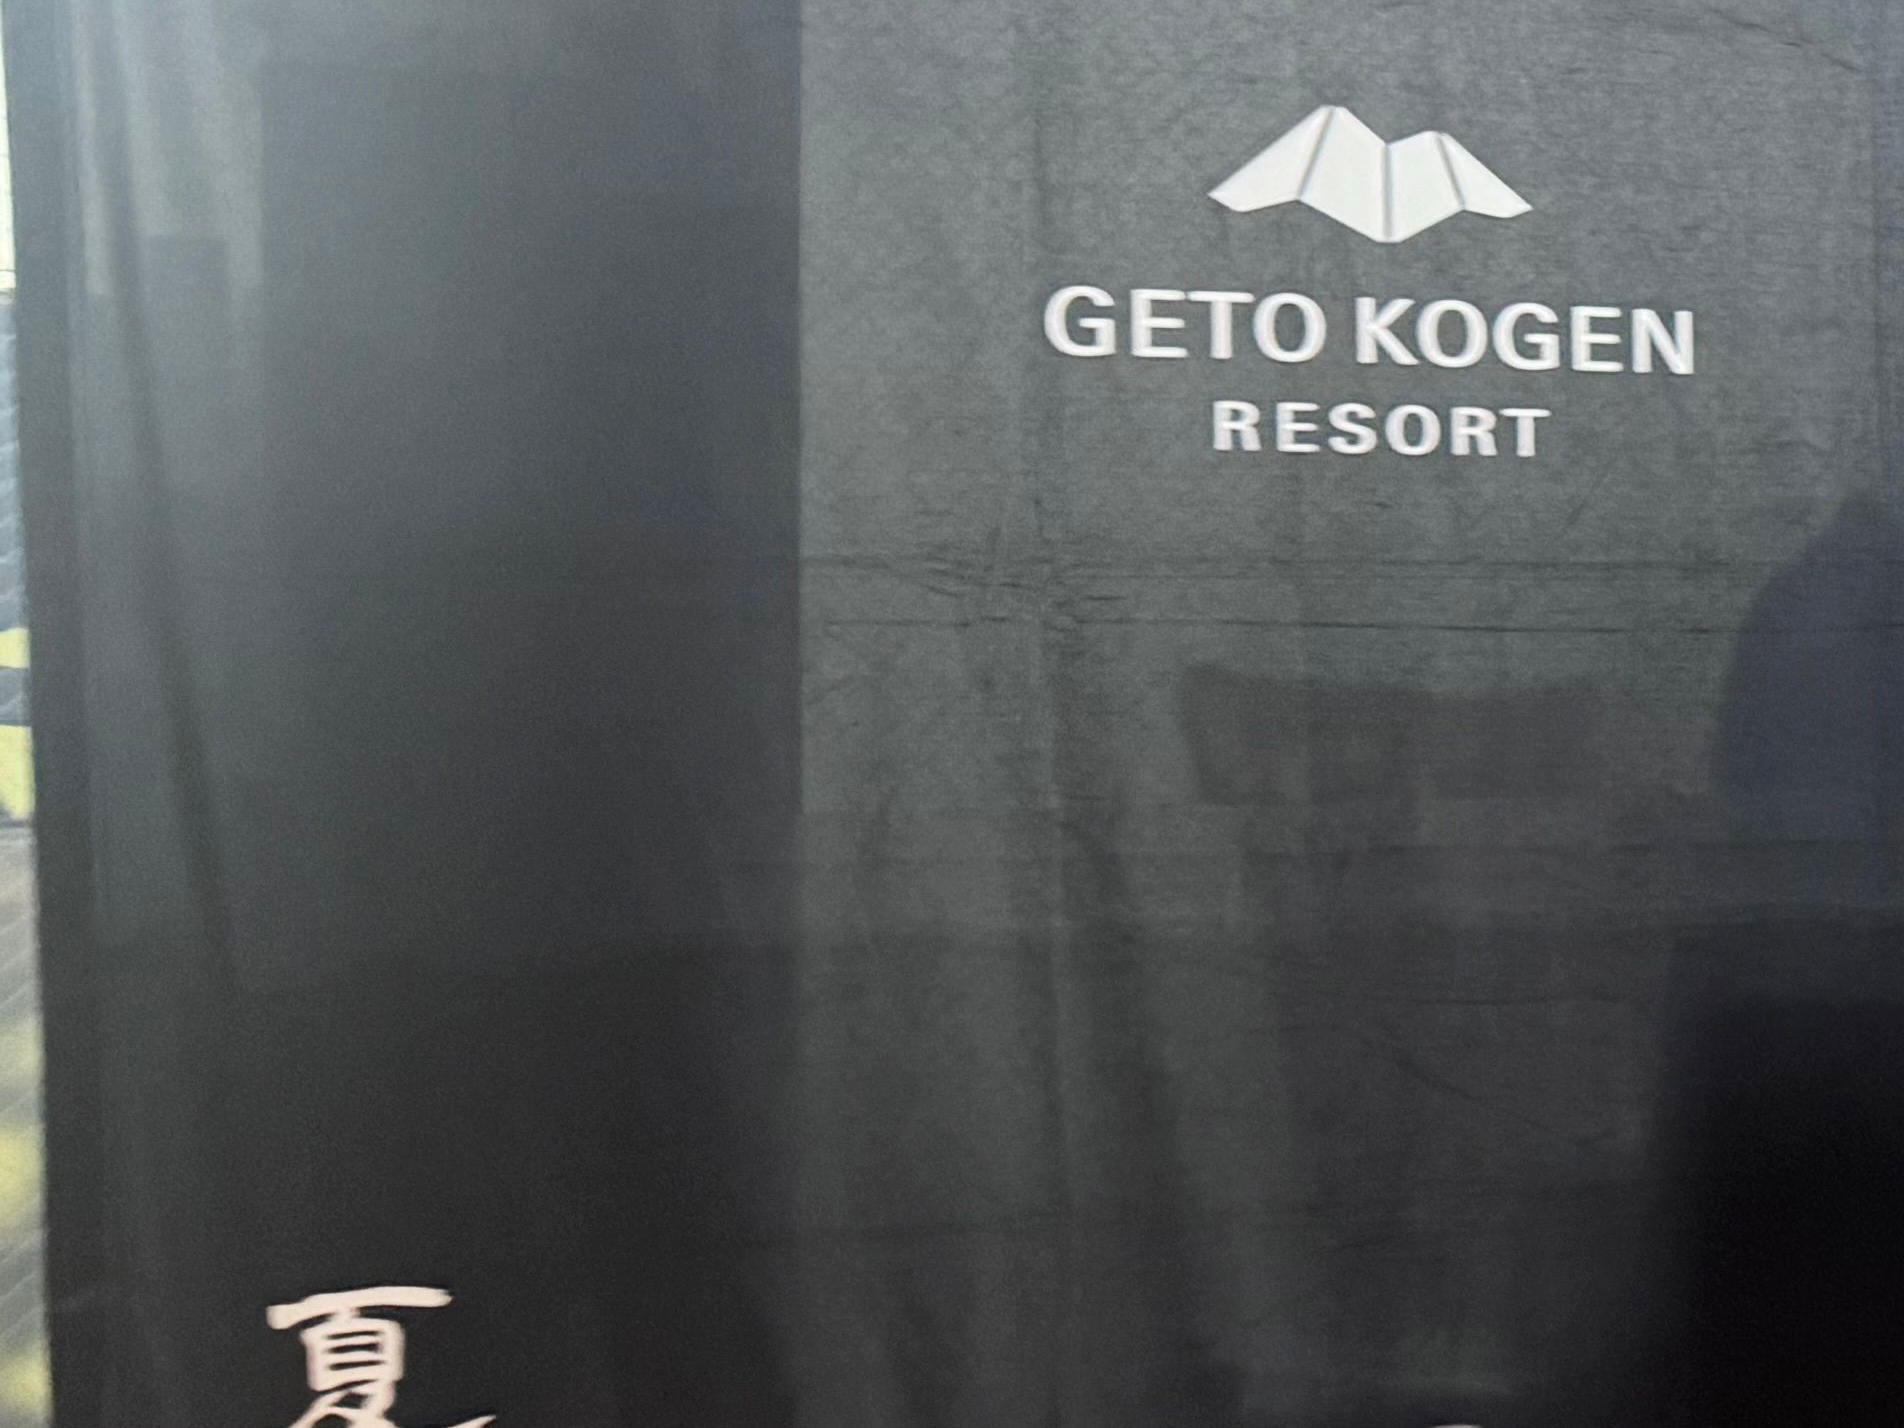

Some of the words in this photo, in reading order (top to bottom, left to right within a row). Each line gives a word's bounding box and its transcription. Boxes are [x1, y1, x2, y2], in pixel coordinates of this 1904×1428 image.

[1043, 285, 1328, 362] GETO
[1353, 294, 1695, 375] KOGEN
[1212, 400, 1551, 457] RESORT
